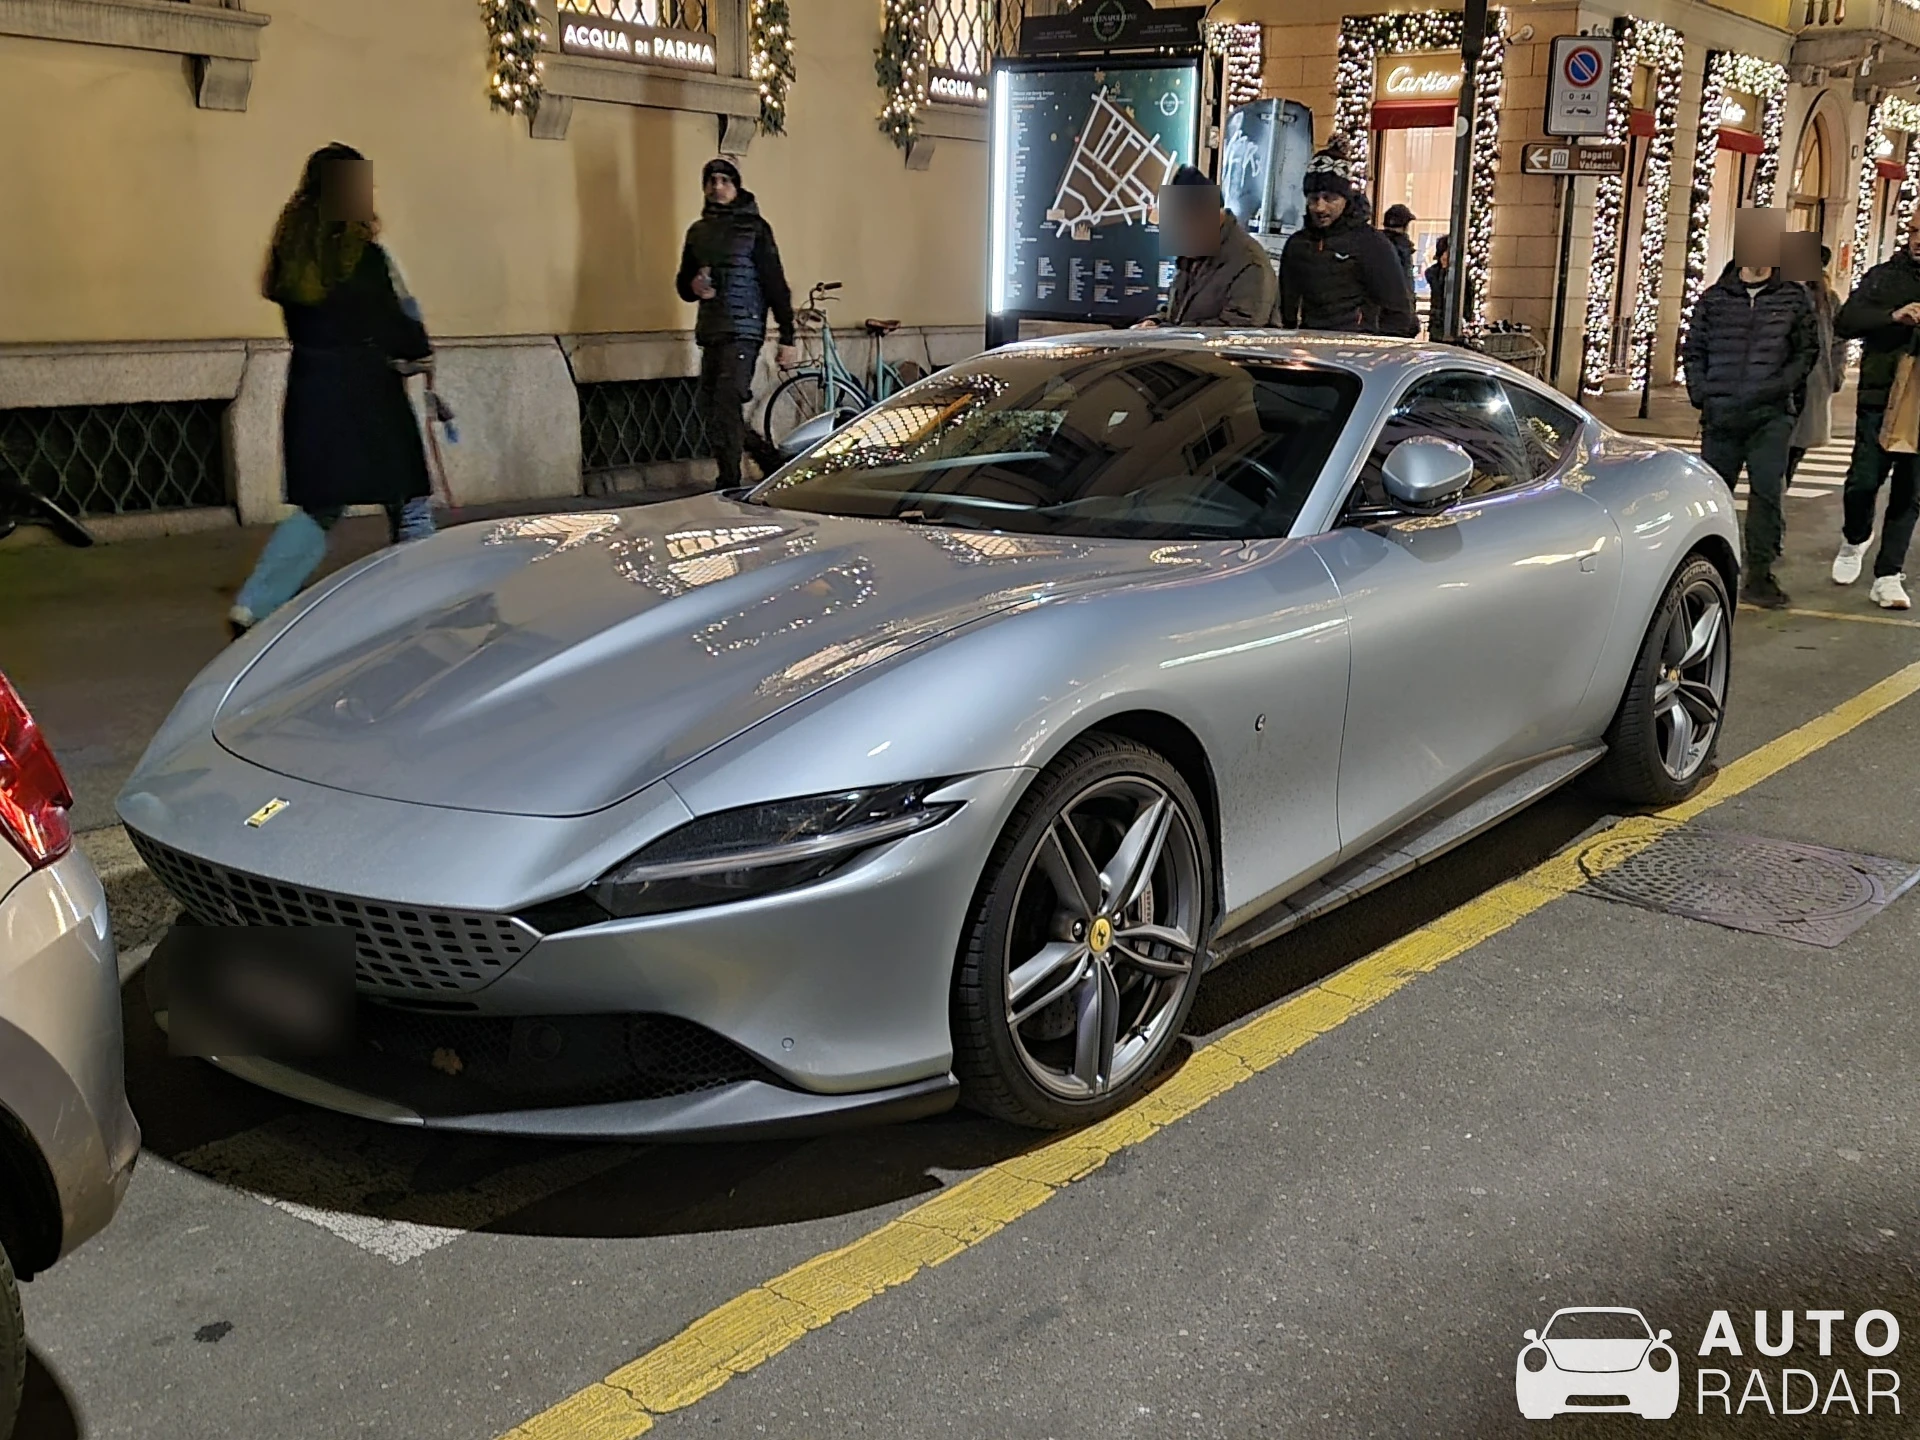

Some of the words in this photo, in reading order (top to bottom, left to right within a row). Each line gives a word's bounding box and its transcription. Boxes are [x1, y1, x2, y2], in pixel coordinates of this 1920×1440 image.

[564, 24, 629, 51] ACQUA
[634, 39, 649, 54] DI
[653, 37, 714, 64] PARMA
[930, 76, 974, 100] ACQUA
[1386, 66, 1460, 93] Cartier
[1579, 160, 1621, 171] Valsecchi
[1580, 149, 1613, 161] Bagatti
